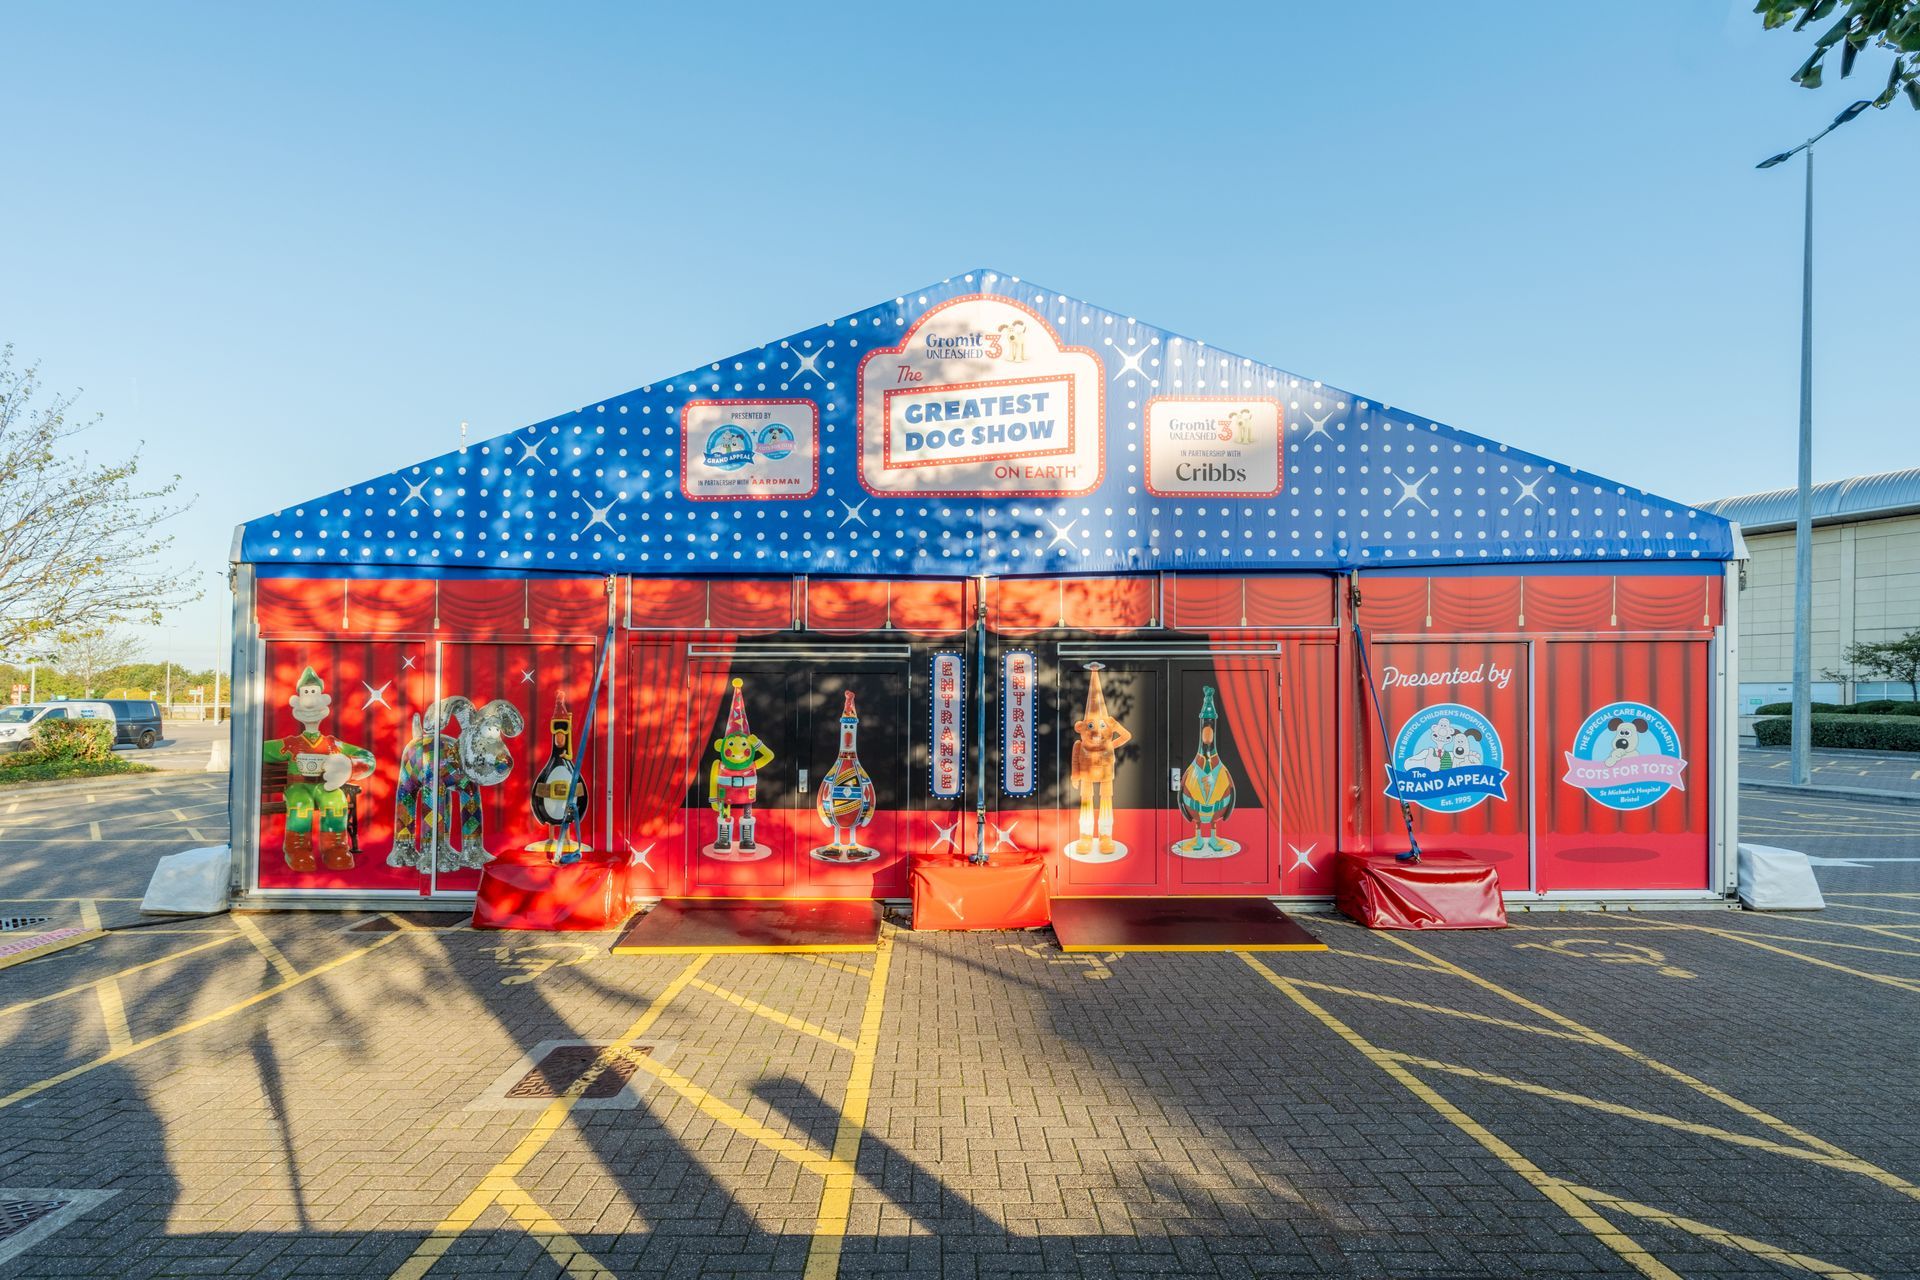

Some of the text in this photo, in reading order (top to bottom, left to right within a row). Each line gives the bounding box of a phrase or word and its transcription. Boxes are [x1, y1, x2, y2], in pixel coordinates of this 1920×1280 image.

[926, 333, 983, 347] Gromit
[984, 334, 1002, 359] 3
[926, 348, 983, 359] UNLEASHED
[897, 366, 923, 384] The
[904, 392, 1050, 424] GREATEST
[1169, 418, 1216, 431] Gromit
[1217, 420, 1233, 441] 3
[905, 420, 1054, 452] DOG SHOW
[1169, 431, 1217, 440] UNLEASHED
[994, 466, 1076, 479] ON EARTH
[1176, 462, 1246, 482] Cribbs
[1382, 663, 1512, 690] Presented by
[940, 662, 954, 789] ENTRANCE
[1012, 660, 1026, 787] ENTRANCE
[1580, 708, 1675, 753] THE SPECIAL CARE BABY CHARITY
[1402, 721, 1421, 744] BRISTOL
[1420, 710, 1460, 724] CHILDREN'S
[1460, 712, 1487, 733] HOSPITAL
[1485, 732, 1498, 761] CHARITY
[1412, 770, 1427, 779] The
[1576, 763, 1674, 780] COTS FOR TOTS
[1398, 773, 1496, 793] GRAND APPEAL
[1608, 788, 1635, 796] Michael's
[1636, 786, 1661, 795] Hospital
[1455, 795, 1472, 805] 1995
